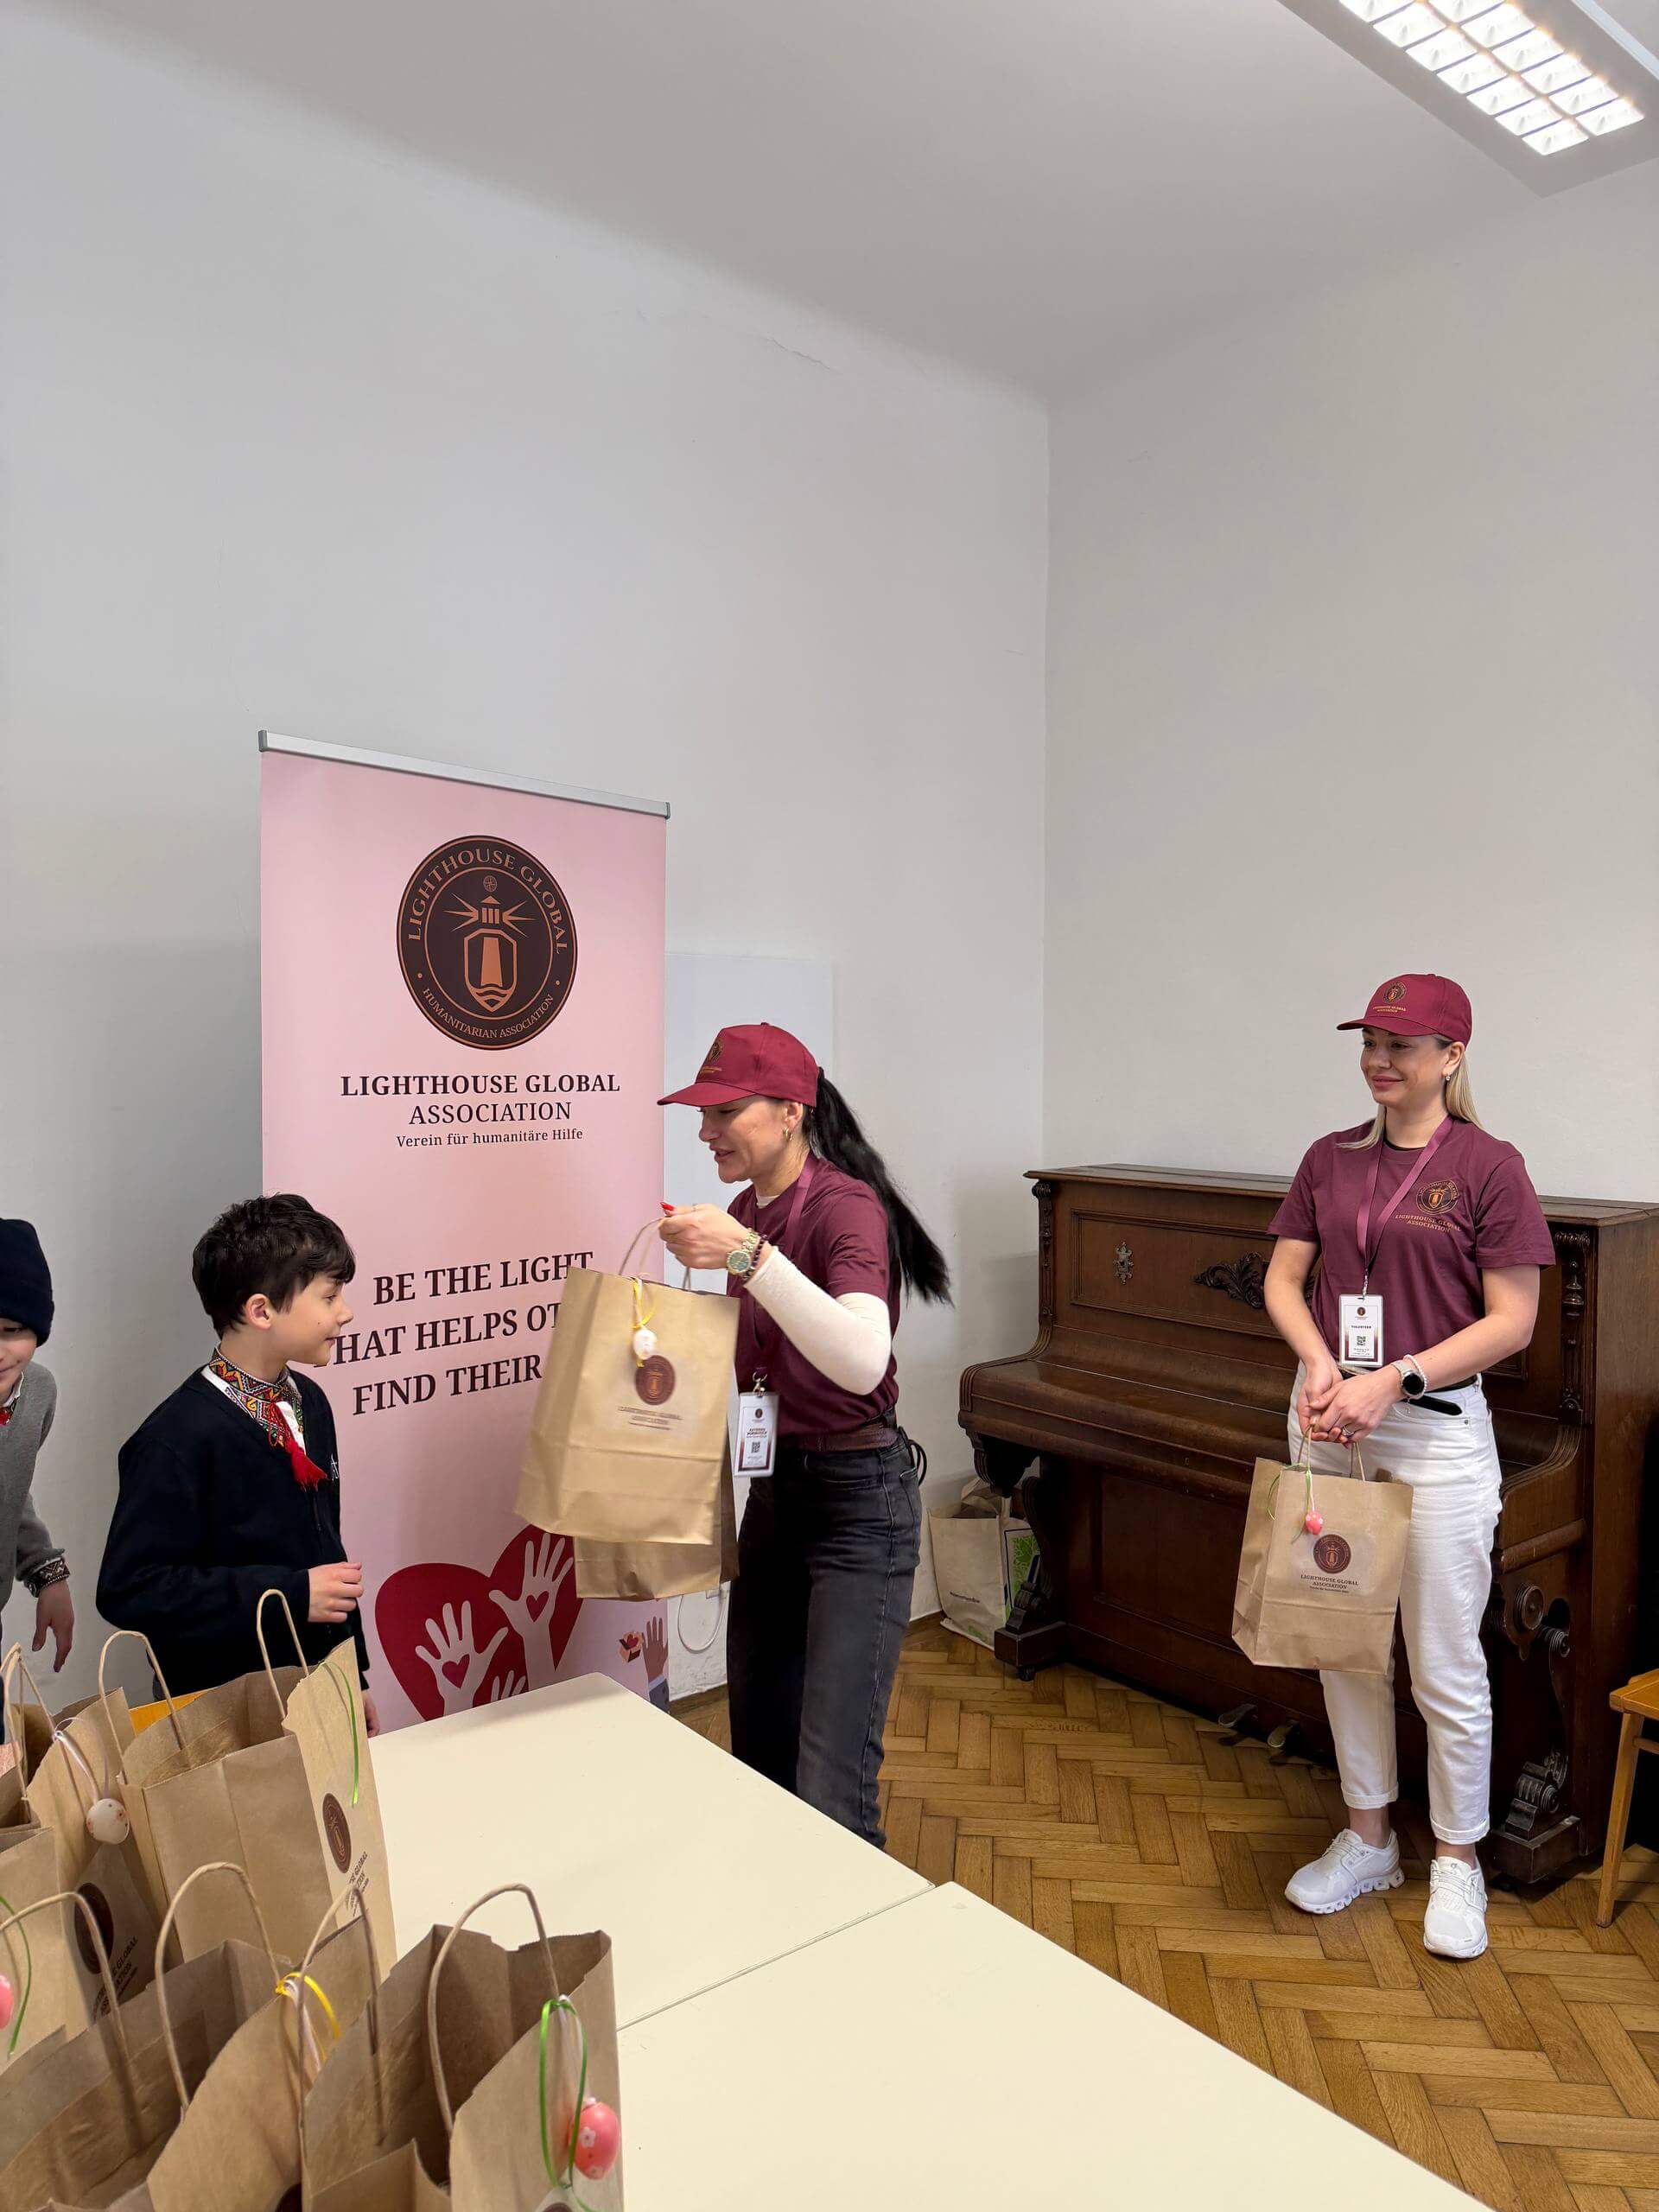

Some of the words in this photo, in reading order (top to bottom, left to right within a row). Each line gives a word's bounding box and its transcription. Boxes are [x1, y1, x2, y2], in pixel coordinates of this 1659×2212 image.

[408, 848, 517, 941] LIGHTHOUSE
[520, 865, 569, 955] GLOBAL
[423, 988, 498, 1039] HUMANITARIAN
[499, 994, 554, 1039] ASSOCIATION
[340, 1075, 518, 1096] LIGHTHOUSE
[524, 1074, 620, 1093] GLOBAL
[397, 1134, 442, 1148] Verein
[446, 1132, 469, 1146] für
[473, 1130, 549, 1145] humanitäre
[552, 1128, 583, 1141] Hilfe
[409, 1102, 572, 1125] ASSOCIATION
[372, 1272, 416, 1306] BE
[424, 1263, 492, 1297] THE
[499, 1251, 594, 1288] LIGHT
[314, 1325, 406, 1368] HAT
[415, 1308, 518, 1351] HELPS
[353, 1373, 436, 1416] FIND
[446, 1354, 543, 1397] THEIR
